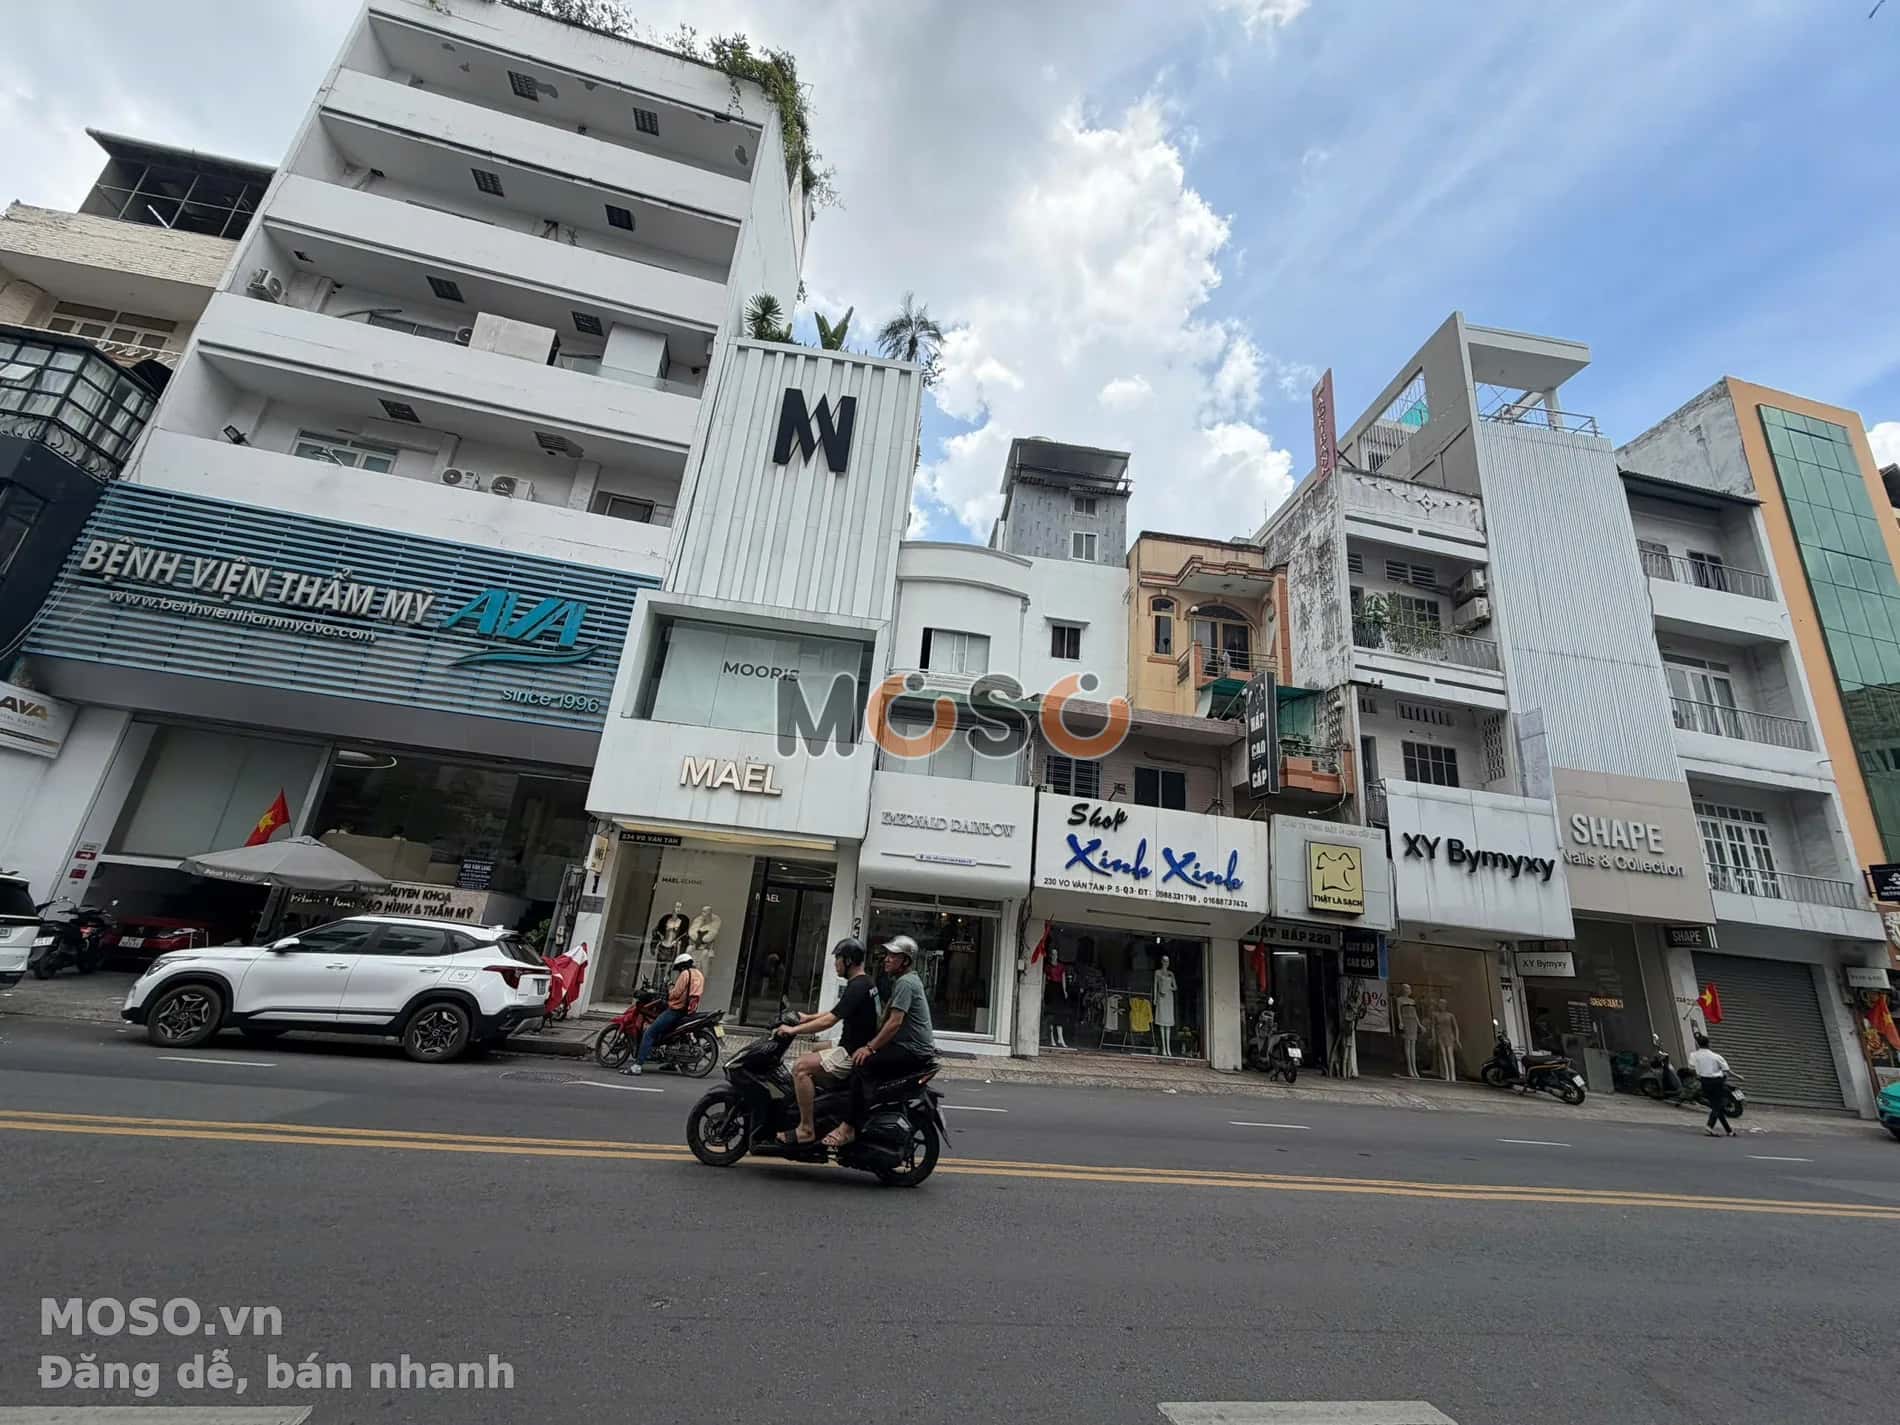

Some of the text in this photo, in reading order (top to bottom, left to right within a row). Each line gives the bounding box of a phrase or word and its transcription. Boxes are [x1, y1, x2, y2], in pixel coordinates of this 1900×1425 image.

[79, 535, 438, 627] BỆNH VIỆN THẨM MỸ
[443, 587, 590, 647] AVA
[501, 686, 601, 714] since 1996
[1067, 802, 1128, 833] Shop
[1570, 812, 1665, 855] SHAPE
[1402, 831, 1556, 883] XY Bymyxy
[1616, 853, 1686, 878] Collection
[1671, 929, 1703, 943] SHAPE
[1522, 959, 1535, 969] XY
